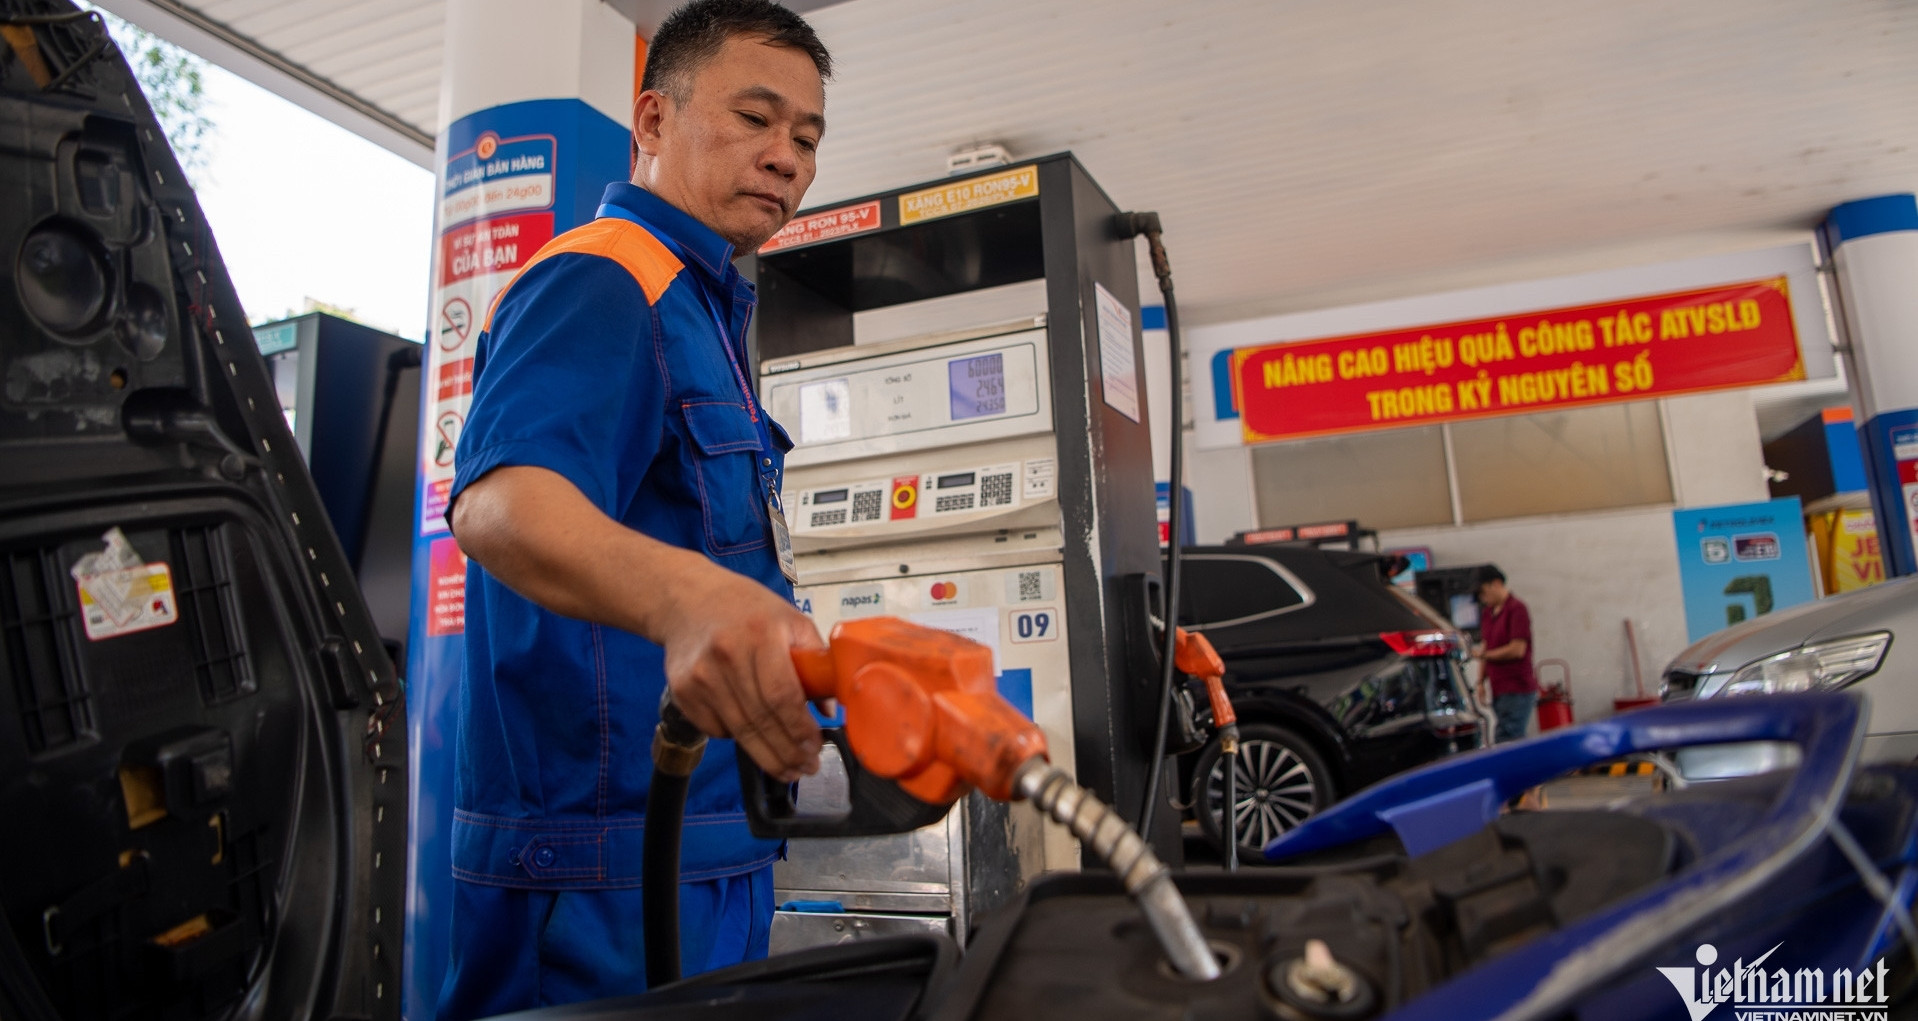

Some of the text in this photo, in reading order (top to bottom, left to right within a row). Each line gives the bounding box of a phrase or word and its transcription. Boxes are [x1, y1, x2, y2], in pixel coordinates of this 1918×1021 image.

[487, 160, 509, 176] BÁN
[511, 155, 545, 172] HÀNG
[907, 192, 944, 212] XĂNG
[946, 187, 971, 204] E10
[808, 215, 837, 230] RON
[840, 208, 870, 224] 95-V
[477, 227, 492, 242] AN
[493, 222, 519, 240] TOÀN
[452, 244, 518, 276] CỦA BẠN
[1262, 299, 1761, 389] NÂNG CAO HIỆU QUẢ CÔNG TÁC ATVSLĐ
[1366, 349, 1654, 420] TRONG KỶ NGUYÊN SỐ
[842, 595, 873, 608] napas
[1017, 613, 1050, 639] 09
